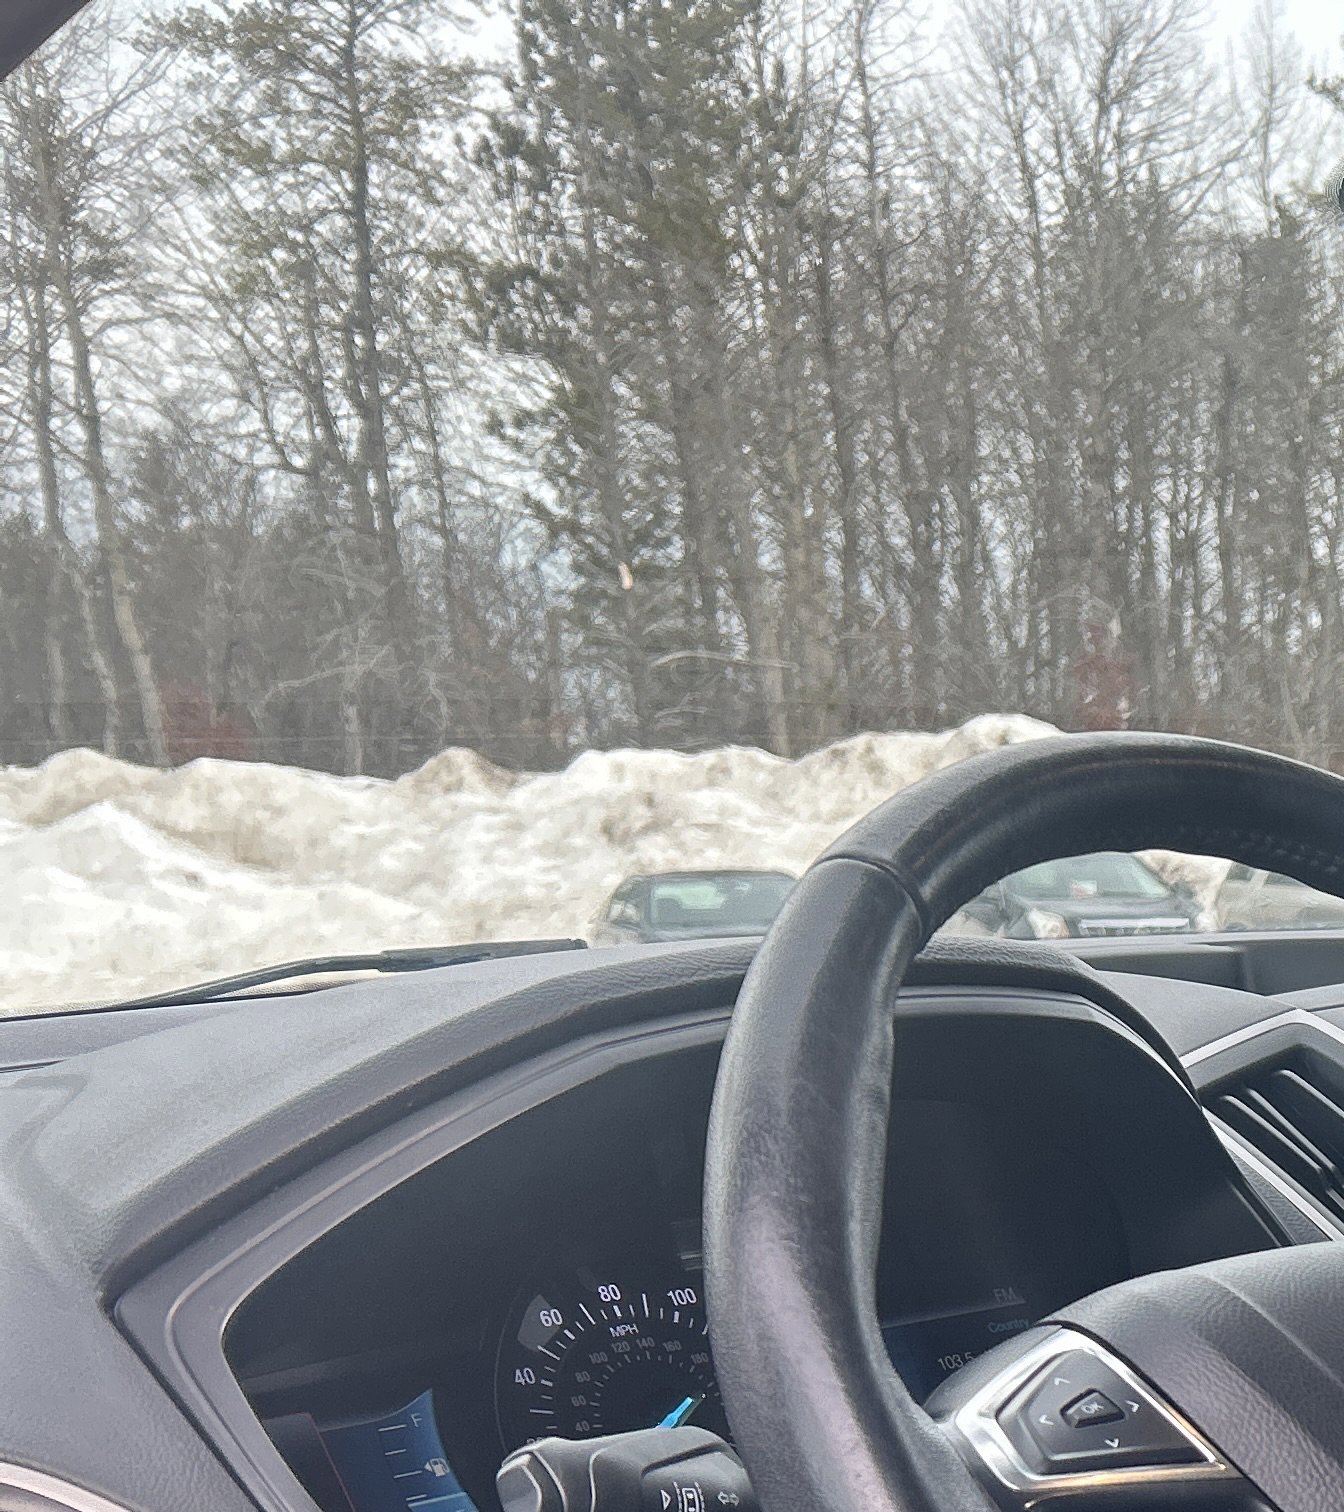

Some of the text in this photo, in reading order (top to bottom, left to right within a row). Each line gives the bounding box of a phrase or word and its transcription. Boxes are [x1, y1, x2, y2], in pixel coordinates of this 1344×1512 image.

[597, 1284, 622, 1302] 80
[667, 1287, 697, 1307] 100
[993, 1287, 1016, 1303] FM
[539, 1308, 563, 1328] 60
[987, 1317, 1030, 1334] Country
[609, 1323, 639, 1338] MPH
[611, 1341, 631, 1353] 120
[636, 1336, 656, 1348] 140
[514, 1367, 537, 1387] 40
[1080, 1401, 1104, 1416] OK
[411, 1412, 423, 1428] F
